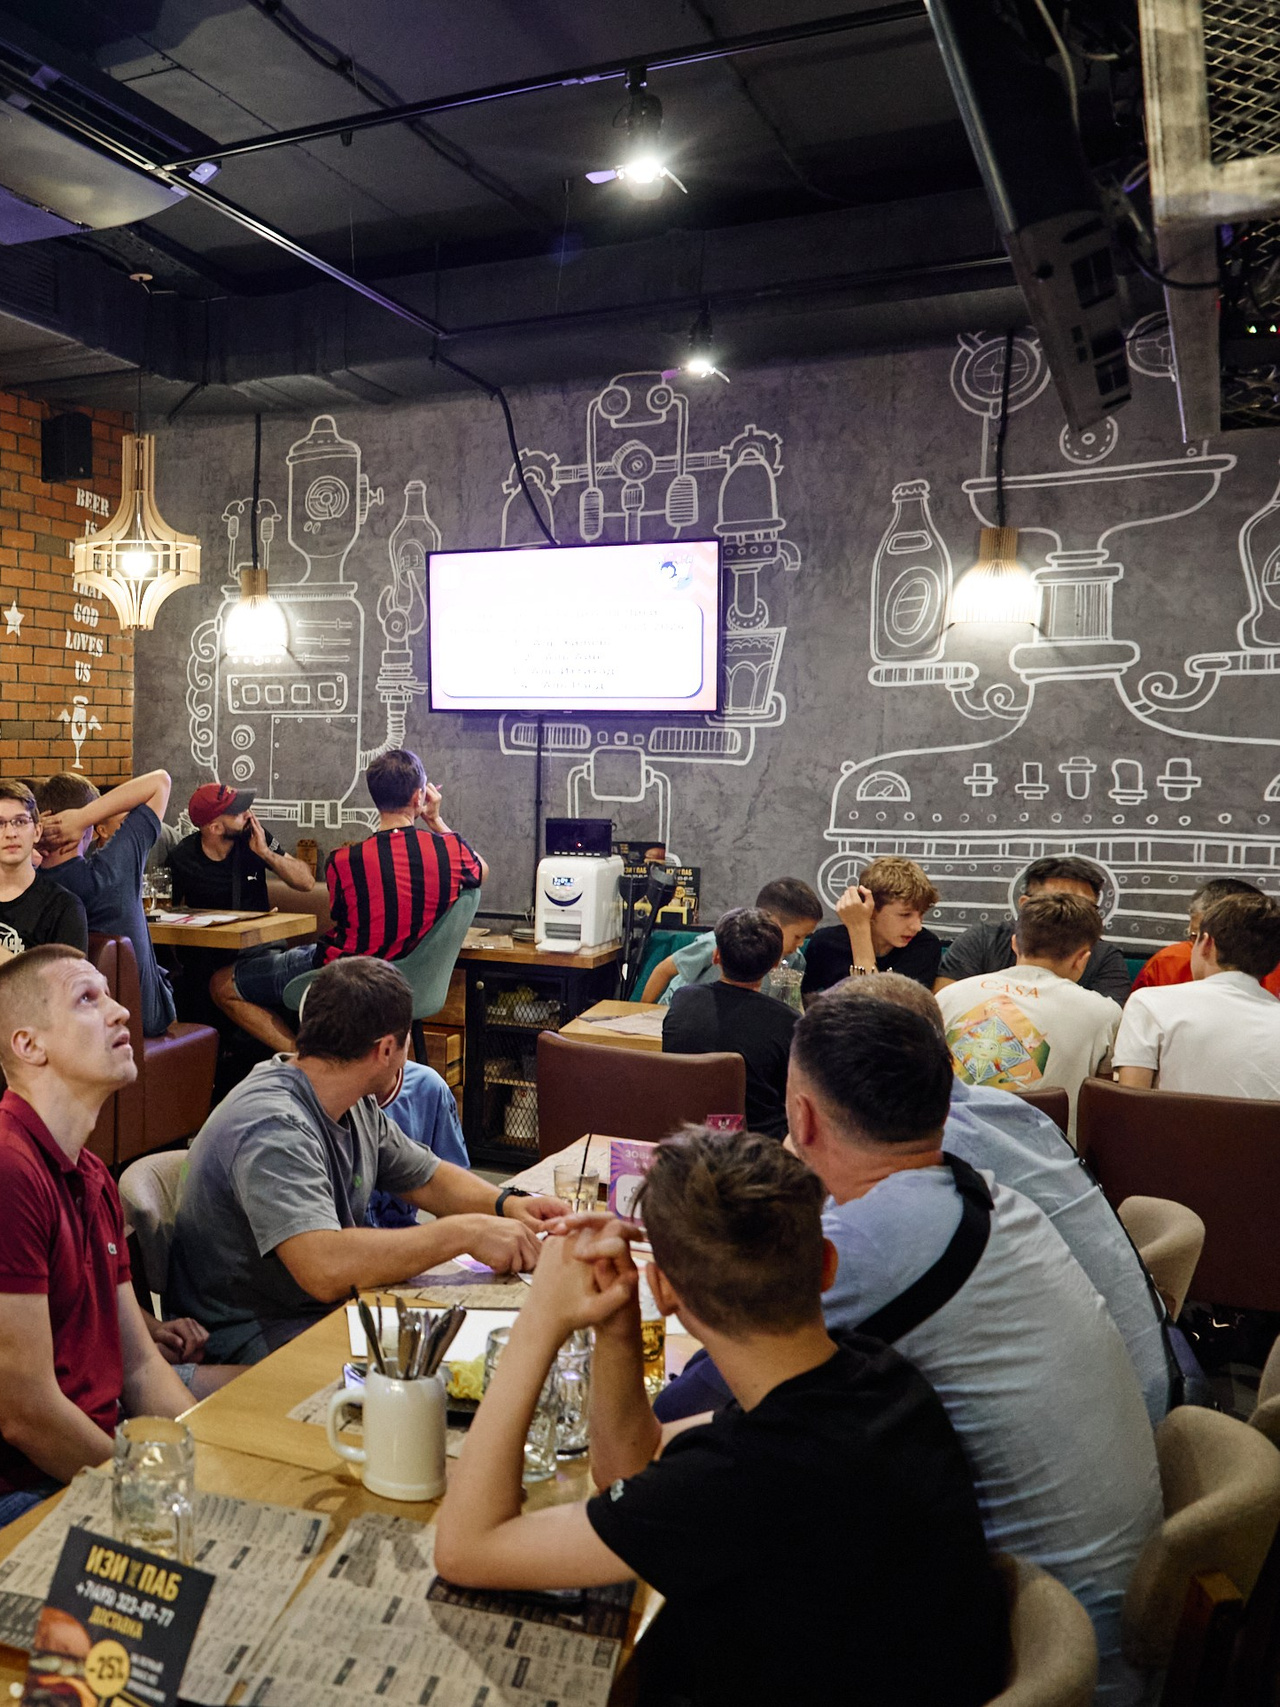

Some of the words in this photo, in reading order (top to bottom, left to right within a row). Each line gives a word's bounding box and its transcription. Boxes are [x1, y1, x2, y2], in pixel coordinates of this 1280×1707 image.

[76, 487, 110, 518] BEER
[73, 602, 99, 628] GOD
[65, 629, 104, 658] LOVES
[74, 660, 91, 683] US
[980, 980, 1039, 999] CASA
[85, 1545, 130, 1584] ИЗИ
[137, 1563, 182, 1602] ПАБ
